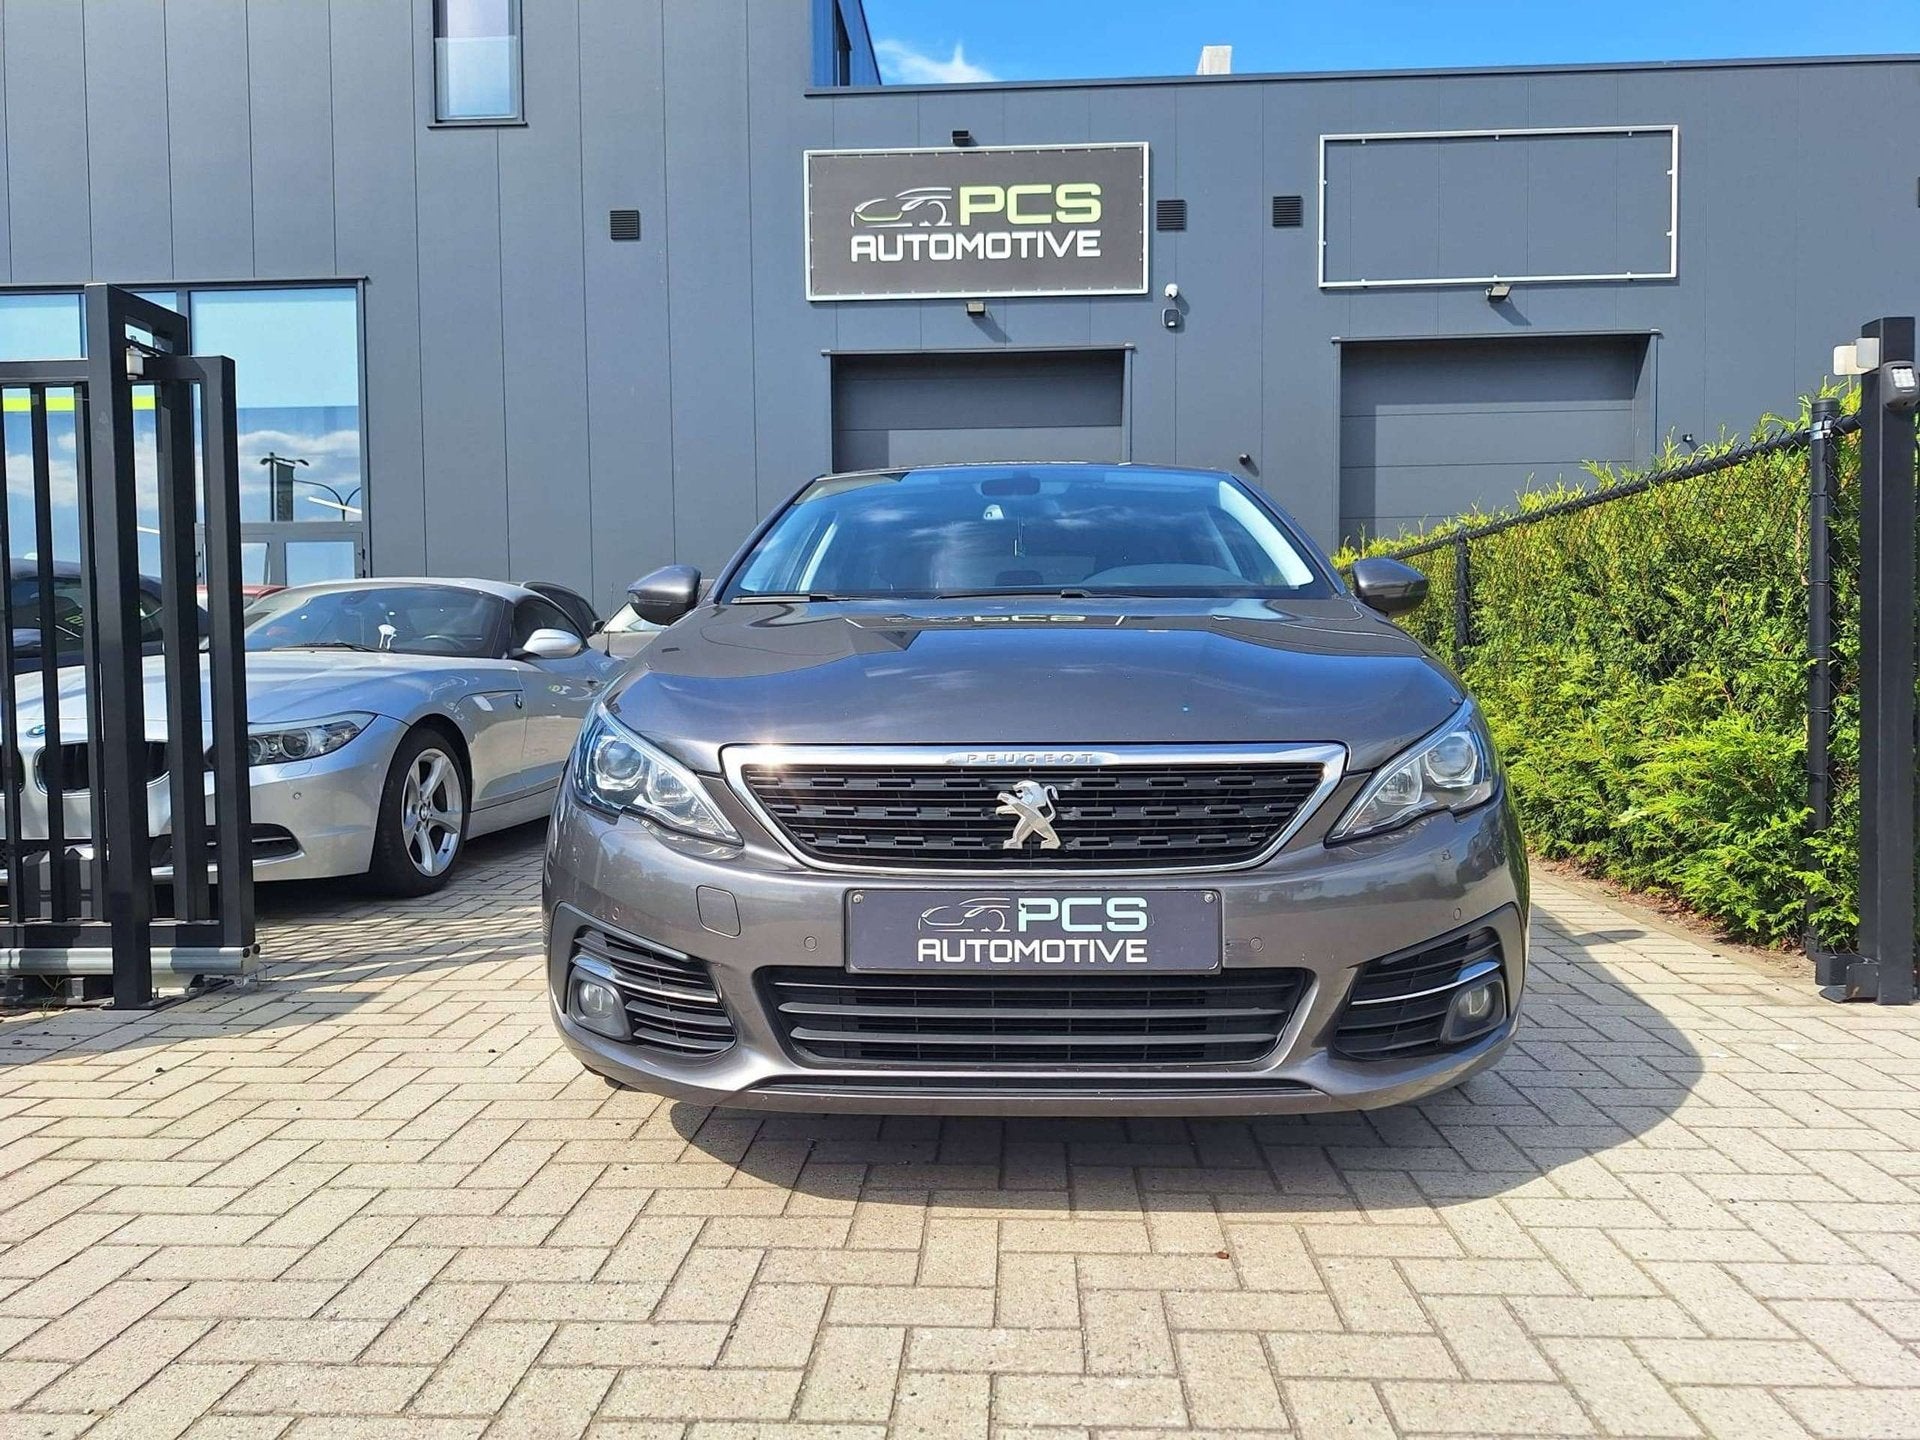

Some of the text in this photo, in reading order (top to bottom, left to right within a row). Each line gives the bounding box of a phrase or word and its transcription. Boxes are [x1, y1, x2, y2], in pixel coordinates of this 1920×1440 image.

[960, 183, 1102, 226] PCS
[850, 229, 1102, 262] AUTOMOTIVE
[966, 753, 1093, 764] PEUGEOT
[1018, 897, 1148, 932] PCS
[917, 939, 1148, 963] AUTOMOTIVE
